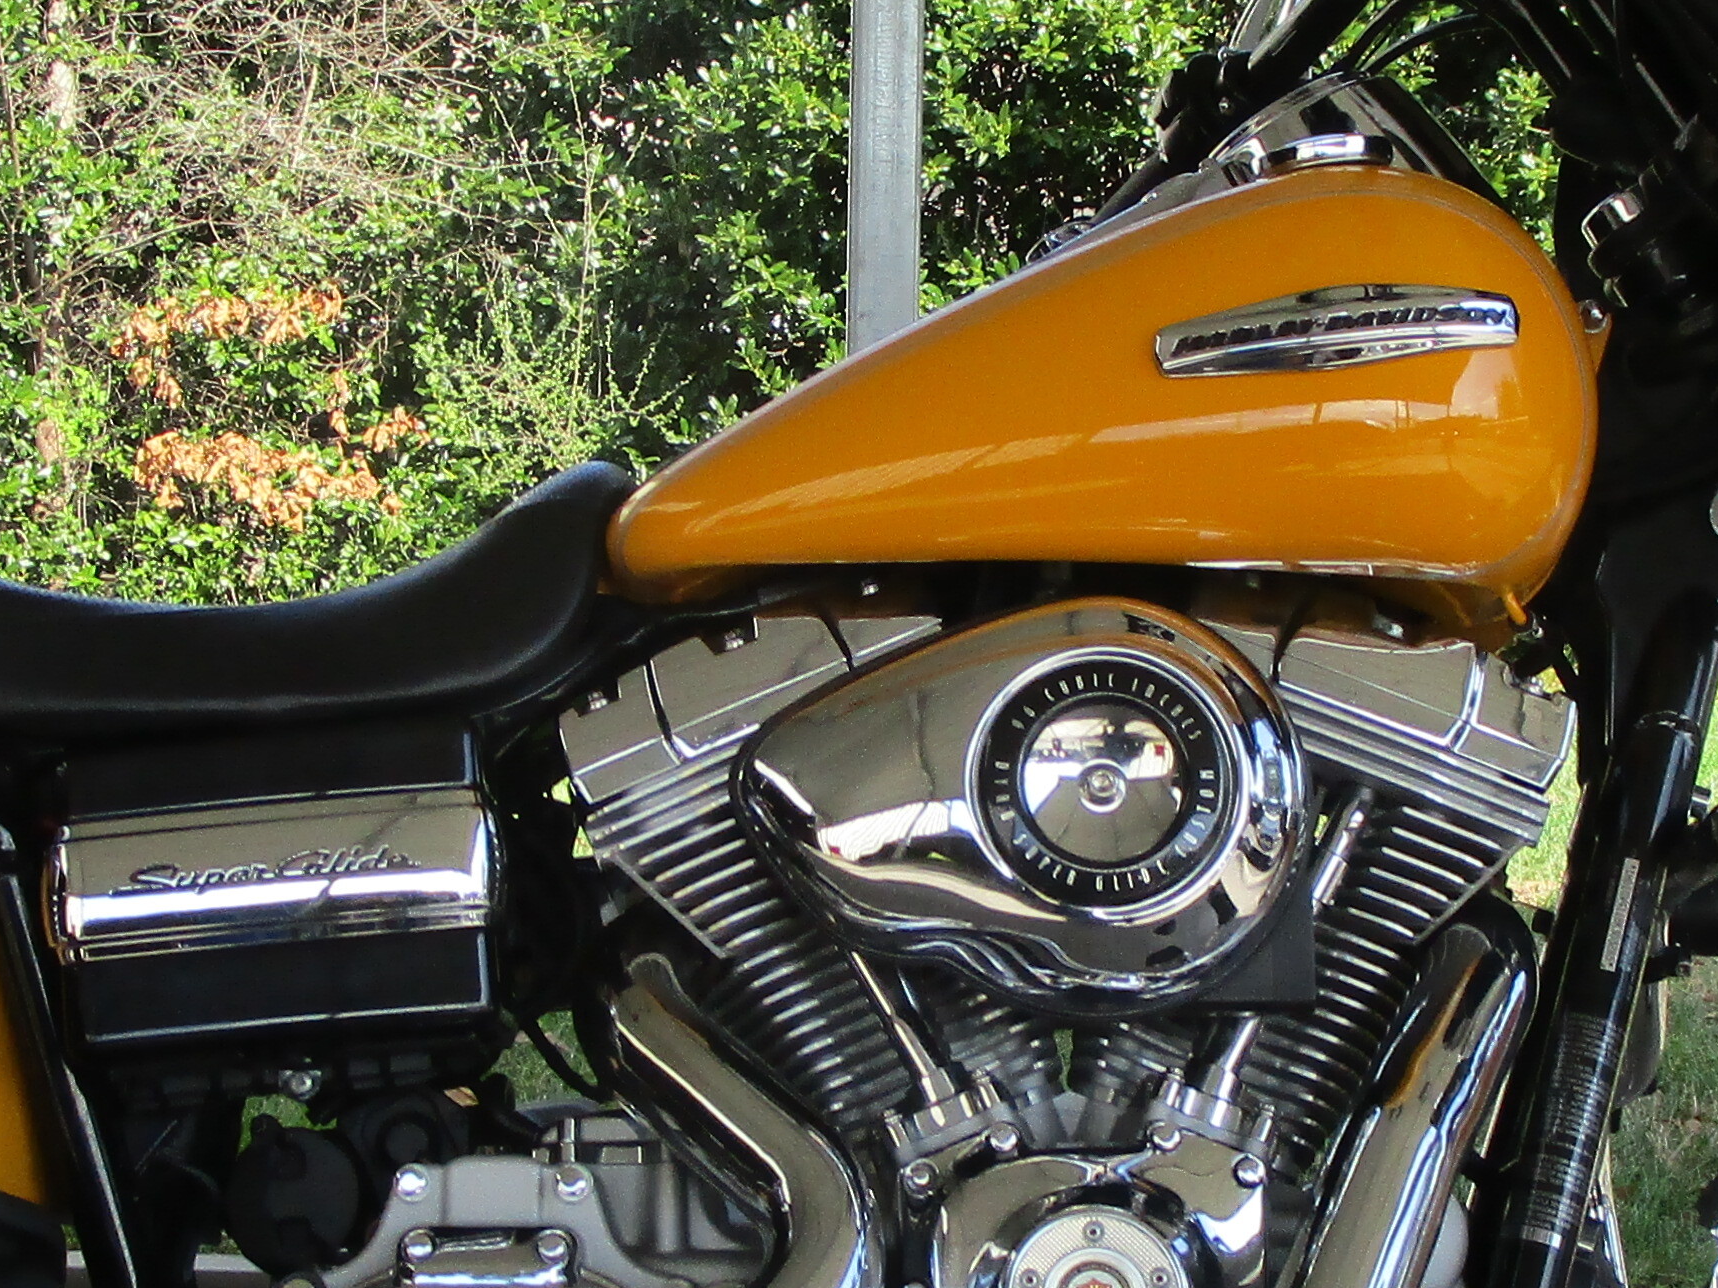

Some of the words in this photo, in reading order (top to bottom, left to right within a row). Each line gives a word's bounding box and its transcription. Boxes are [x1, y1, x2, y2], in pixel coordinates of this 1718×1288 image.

[1044, 672, 1115, 702] CUBIC
[1131, 677, 1202, 741] INCHES
[1012, 833, 1077, 886] SUPER
[1095, 859, 1169, 892] GLIDE
[1174, 769, 1216, 859] CUSTOM
[109, 862, 275, 895] Super
[276, 843, 421, 878] Glide
